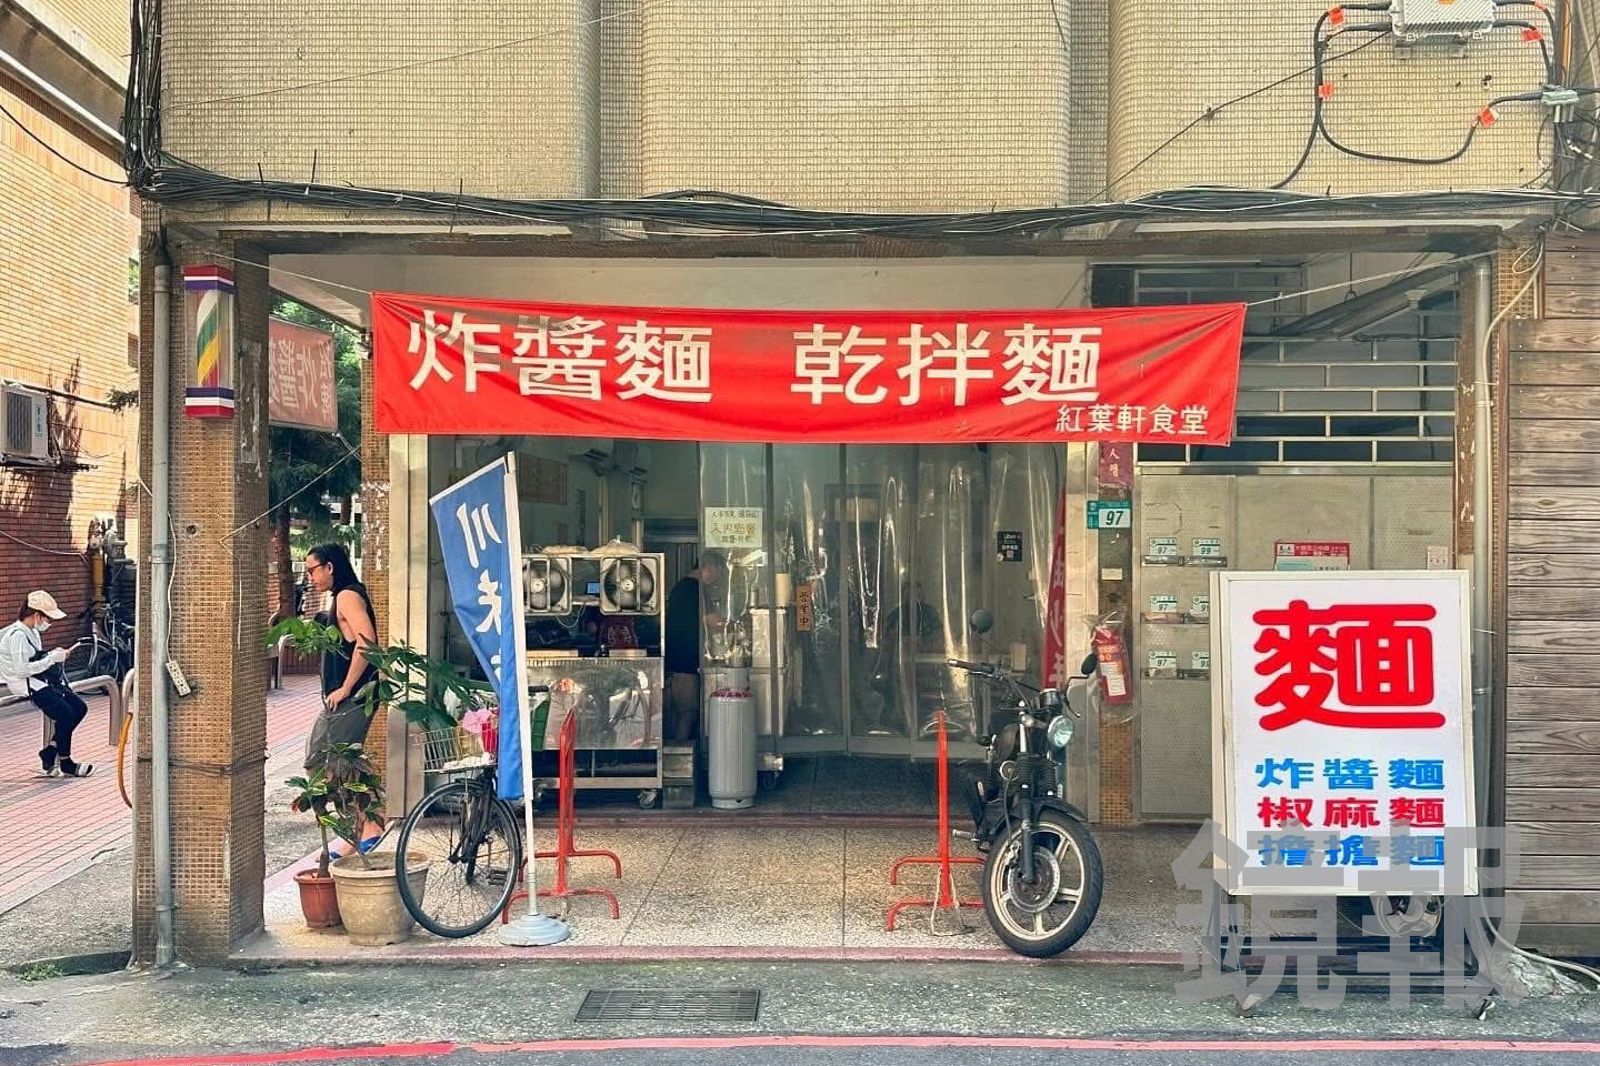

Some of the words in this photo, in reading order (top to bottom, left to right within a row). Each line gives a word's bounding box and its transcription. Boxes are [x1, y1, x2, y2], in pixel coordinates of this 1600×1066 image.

[408, 309, 713, 403] 炸醬麵
[790, 322, 1102, 406] 乾拌麵
[1055, 403, 1209, 435] 紅葉軒食堂
[1105, 510, 1124, 526] 97
[1252, 599, 1446, 732] 麵
[1255, 758, 1445, 790] 炸醬麵
[1257, 797, 1446, 828] 椒麻麵
[1257, 834, 1445, 866] 擔擔麵
